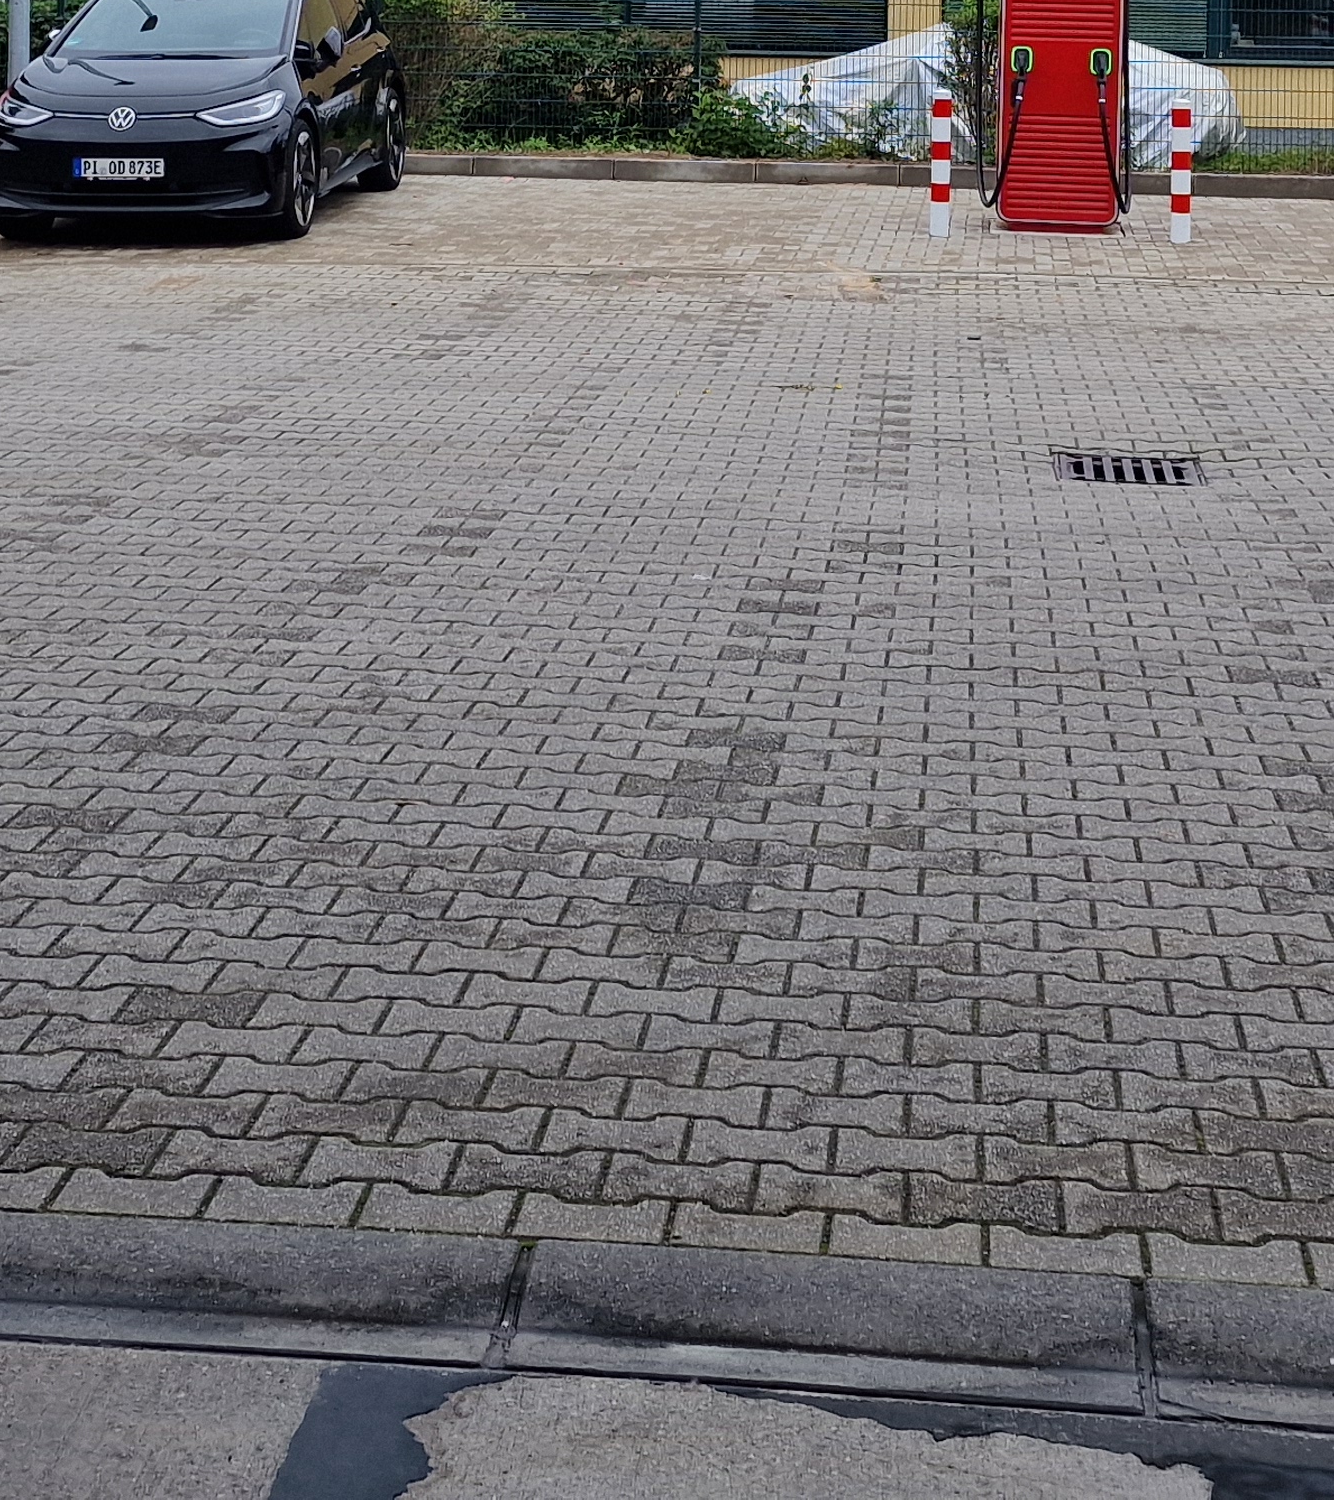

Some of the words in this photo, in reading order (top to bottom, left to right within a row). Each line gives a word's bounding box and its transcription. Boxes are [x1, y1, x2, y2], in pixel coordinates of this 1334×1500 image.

[108, 106, 136, 131] VW
[83, 160, 99, 175] PI
[109, 160, 125, 175] OD
[129, 160, 162, 175] 873E
